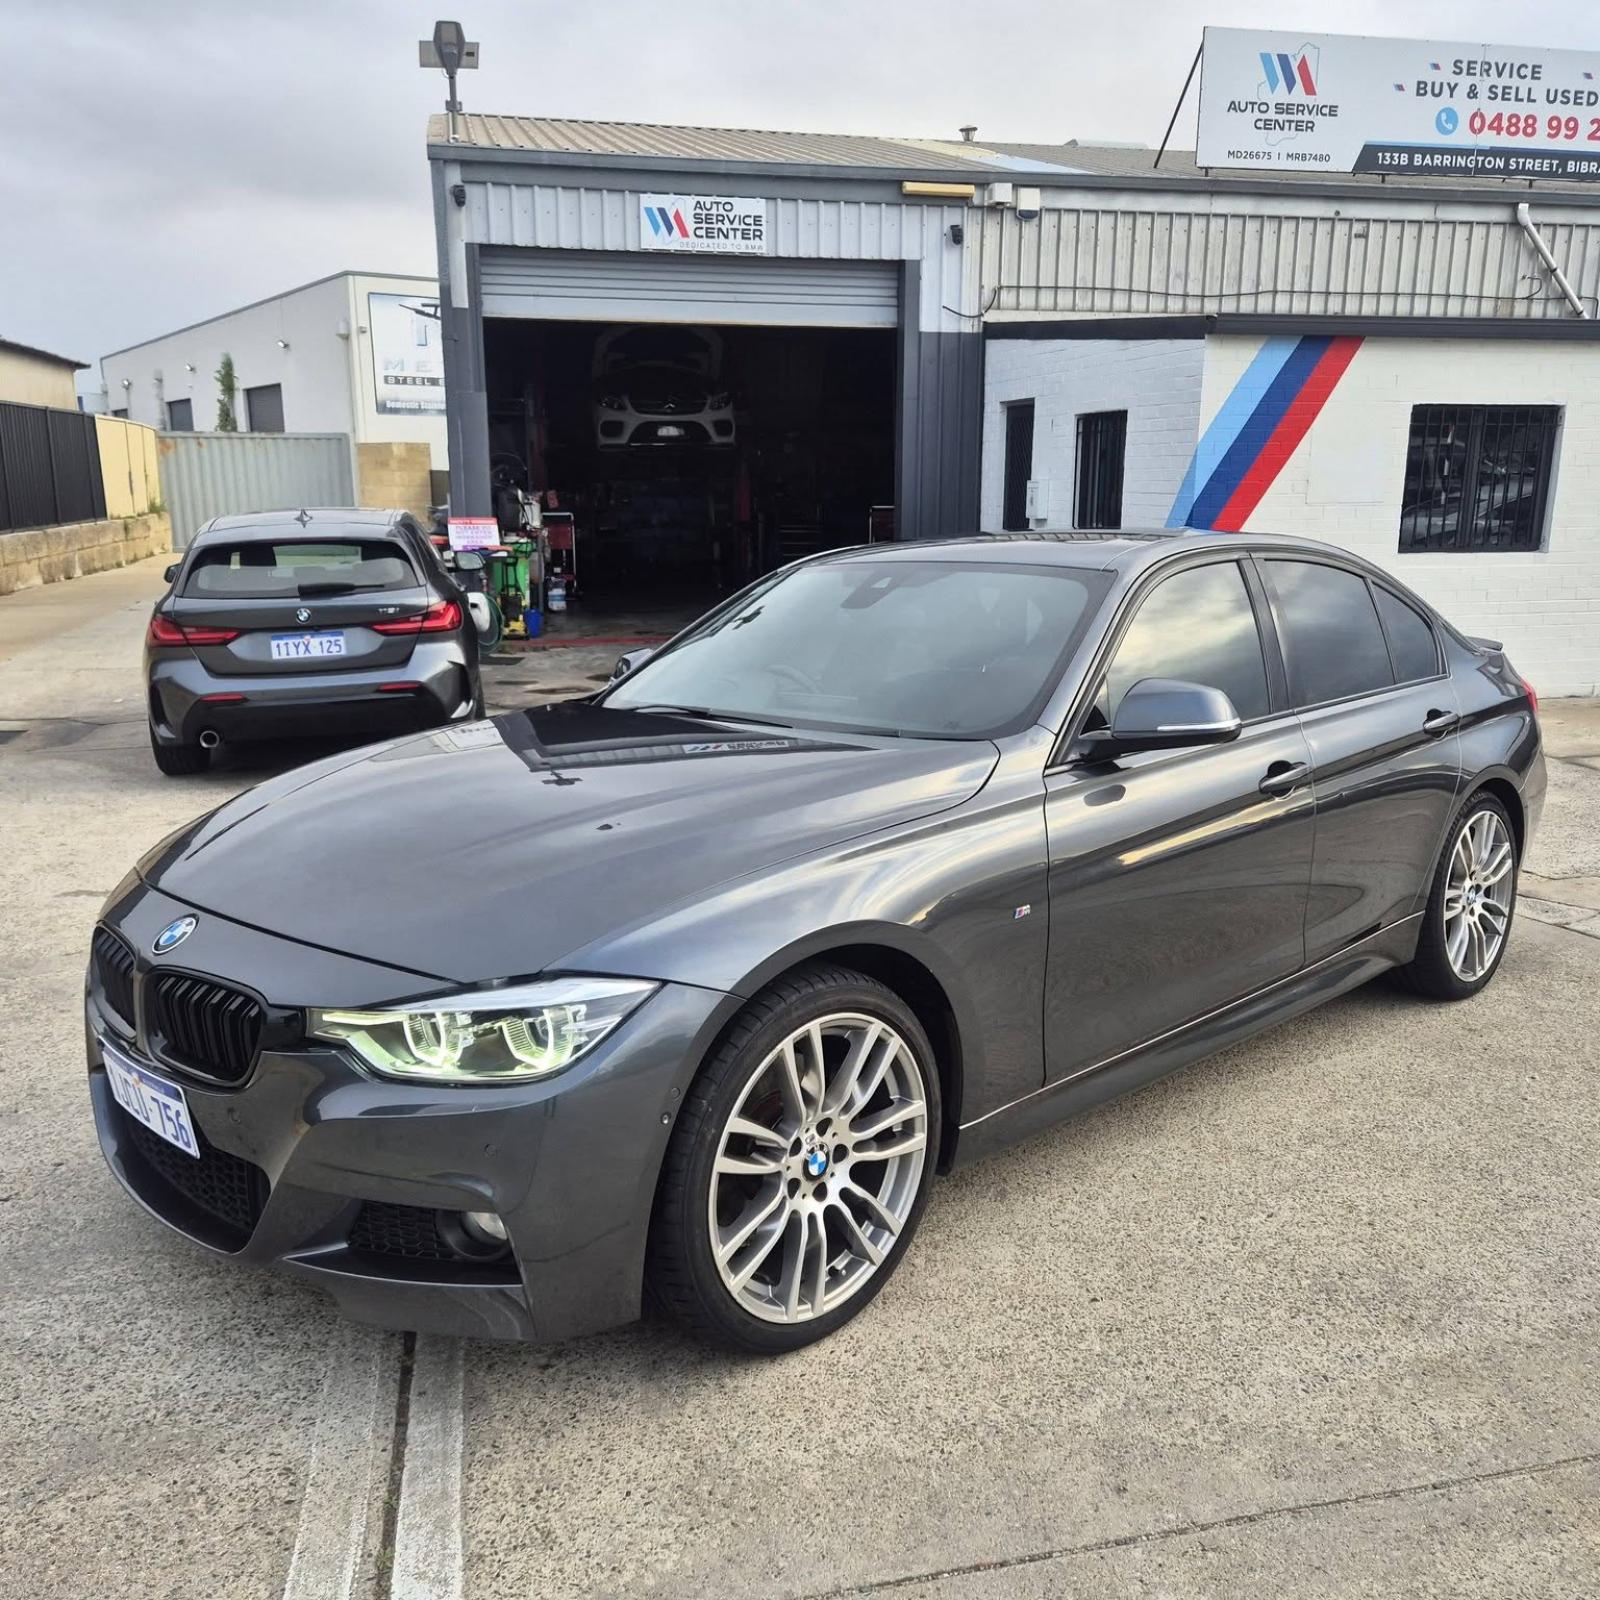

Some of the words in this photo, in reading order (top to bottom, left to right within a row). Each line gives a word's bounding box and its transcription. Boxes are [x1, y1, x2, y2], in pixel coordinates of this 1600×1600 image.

[1452, 59, 1543, 81] SERVICE
[1415, 80, 1459, 99] BUY
[1466, 83, 1479, 100] &
[1487, 84, 1537, 103] SELL
[1545, 88, 1599, 107] USED
[1227, 100, 1270, 114] AUTO
[1274, 102, 1339, 117] SERVICE
[1254, 118, 1316, 132] CENTER
[1468, 110, 1538, 138] 0488
[1546, 115, 1579, 140] 99
[1227, 150, 1272, 160] MD26675
[1286, 152, 1331, 163] MRB7480
[1377, 152, 1409, 166] 133B
[1413, 153, 1505, 170] BARRINGTON
[1508, 156, 1562, 174] STREET,
[693, 200, 734, 212] AUTO
[693, 213, 763, 227] SERVICE
[693, 226, 763, 241] CENTER
[679, 241, 728, 250] DEDICATED
[387, 376, 431, 386] STEEL
[319, 639, 343, 654] 125
